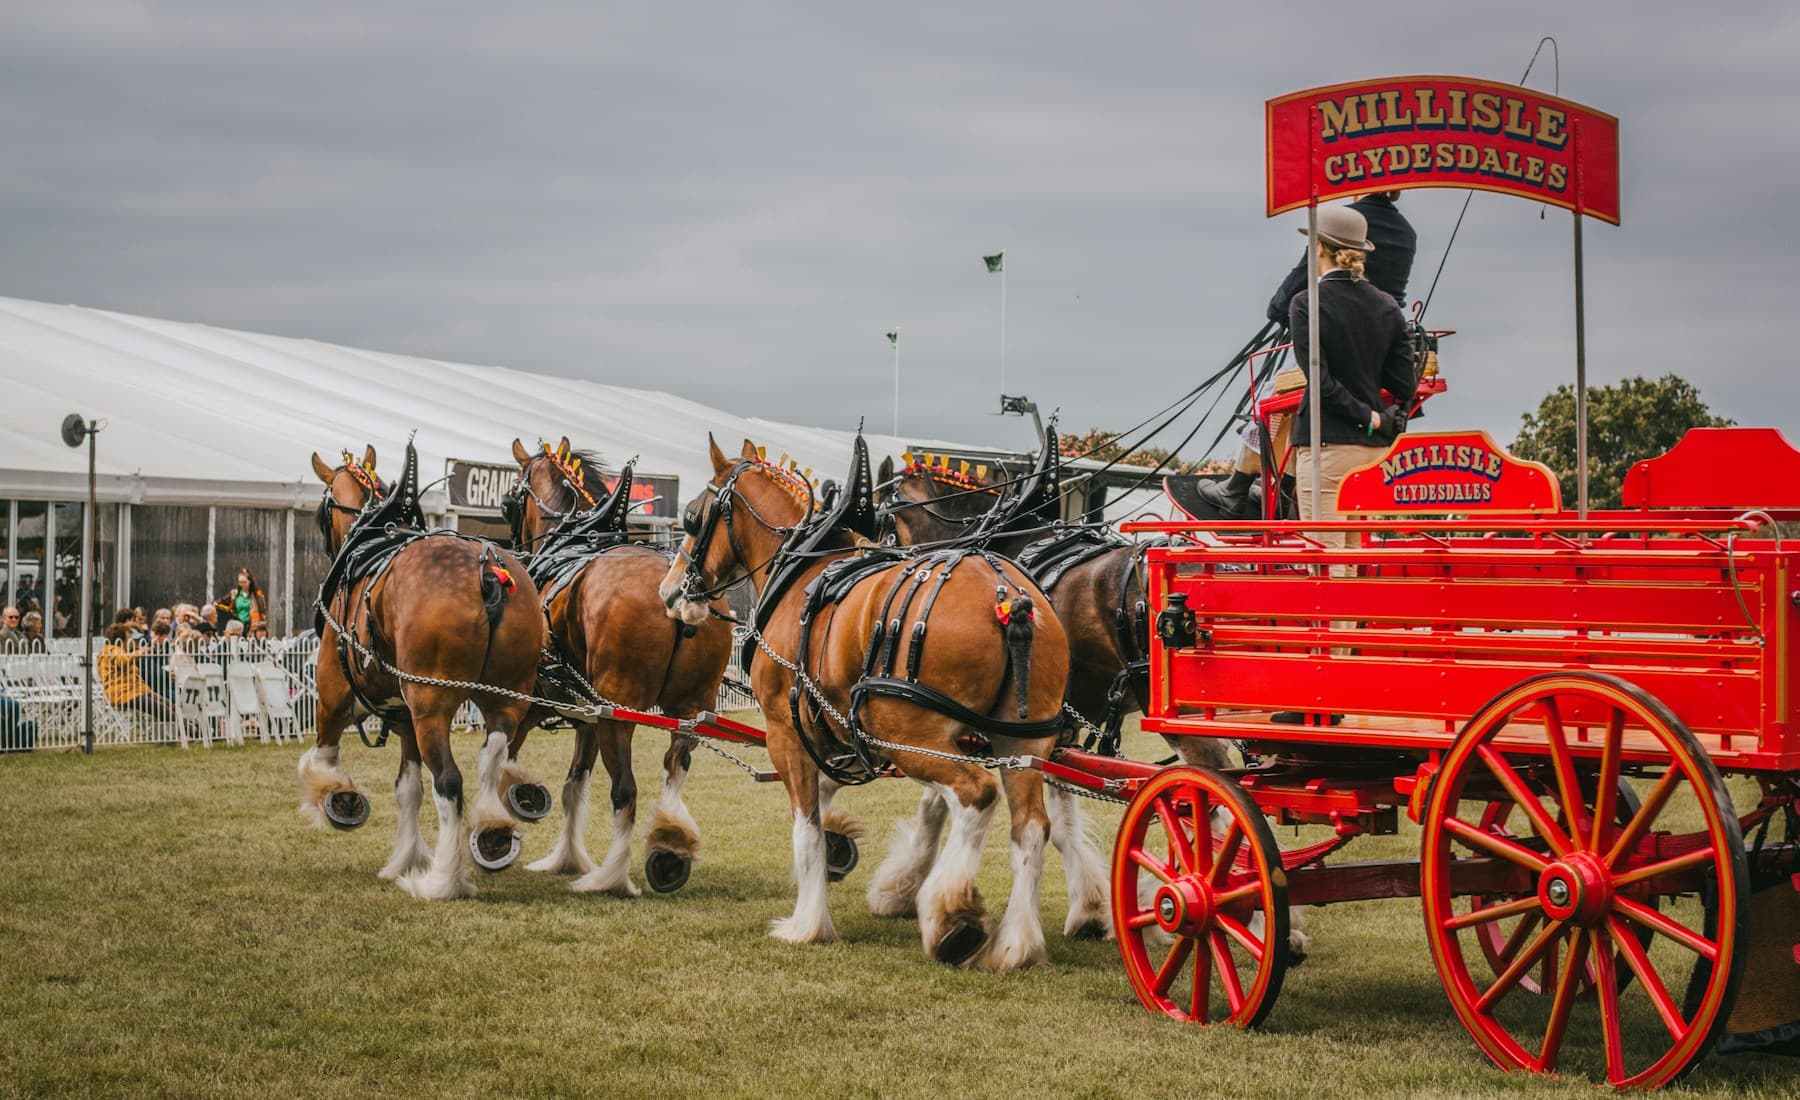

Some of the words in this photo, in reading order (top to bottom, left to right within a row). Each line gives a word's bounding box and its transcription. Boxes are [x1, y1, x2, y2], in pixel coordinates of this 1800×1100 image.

[1318, 88, 1569, 149] MILLISLE
[1324, 143, 1568, 192] CLYDESDALES
[1379, 444, 1502, 485] MILLISLE
[1393, 483, 1492, 504] CLYDESDALES
[186, 688, 199, 704] TP
